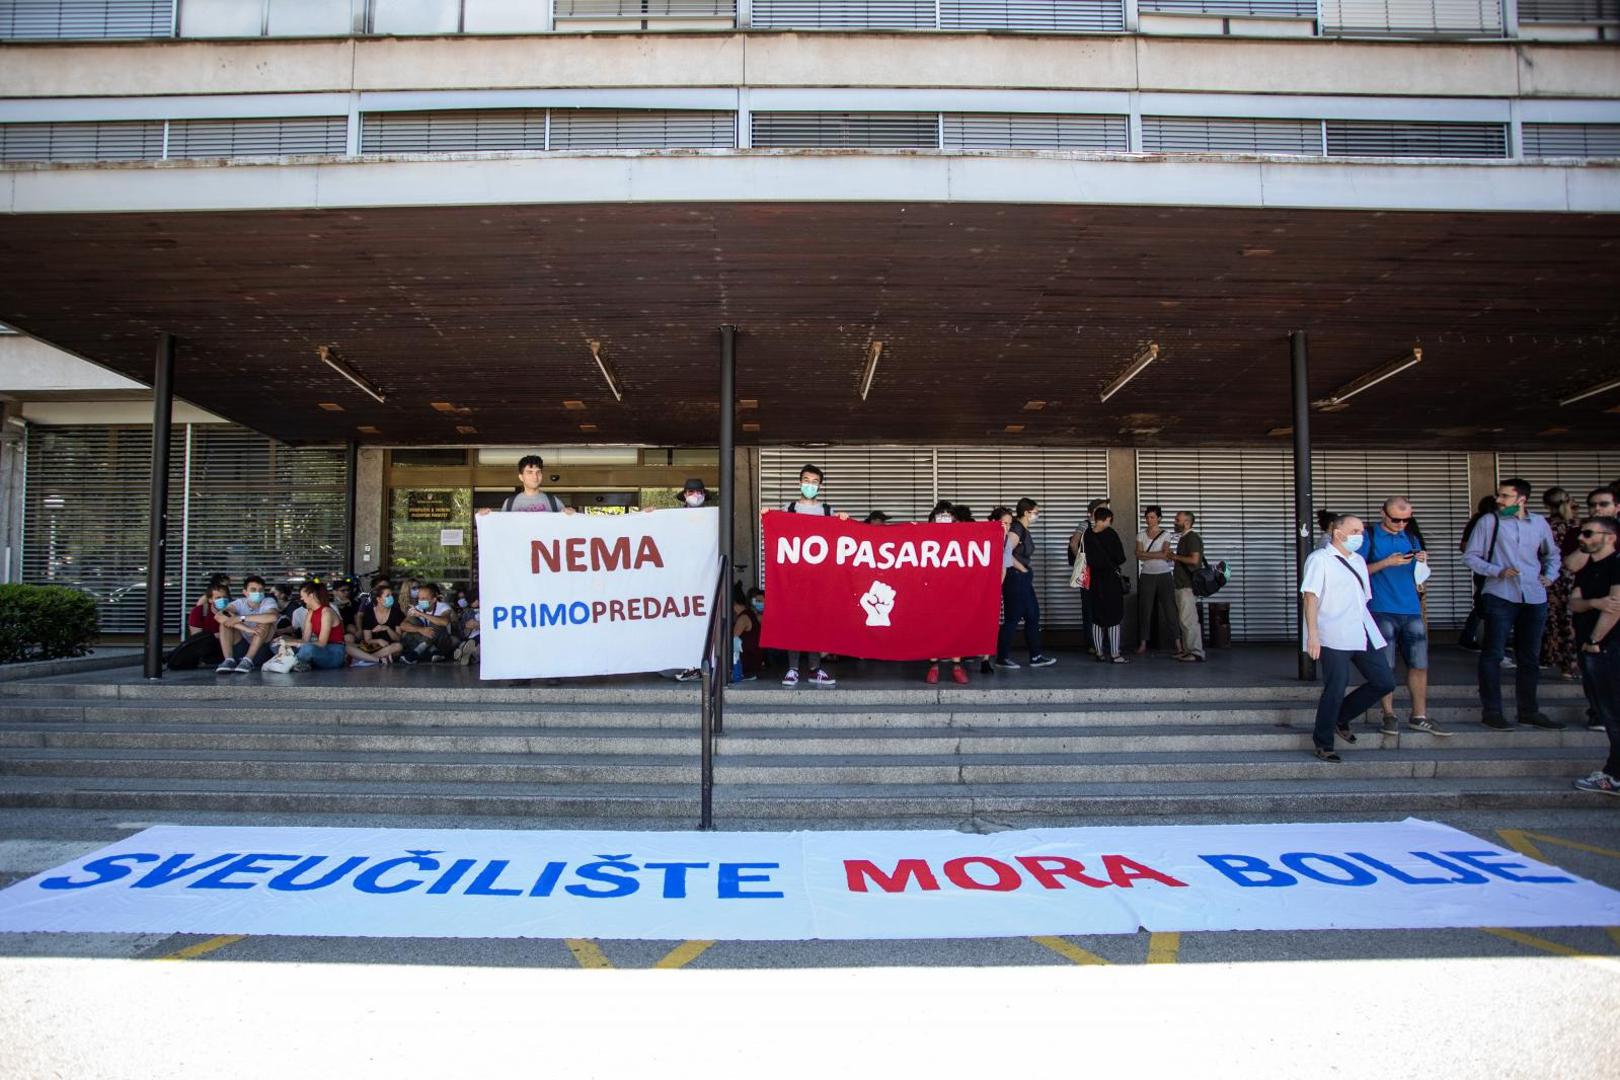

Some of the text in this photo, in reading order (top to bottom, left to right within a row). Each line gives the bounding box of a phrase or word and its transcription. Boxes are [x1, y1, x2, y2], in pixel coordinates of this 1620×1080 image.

[532, 536, 664, 574] NEMA
[776, 535, 991, 570] NO PASARAN
[493, 594, 707, 630] PRIMOPREDAJE
[39, 848, 1577, 901] SVEUČILIŠTE MORA BOLJE
